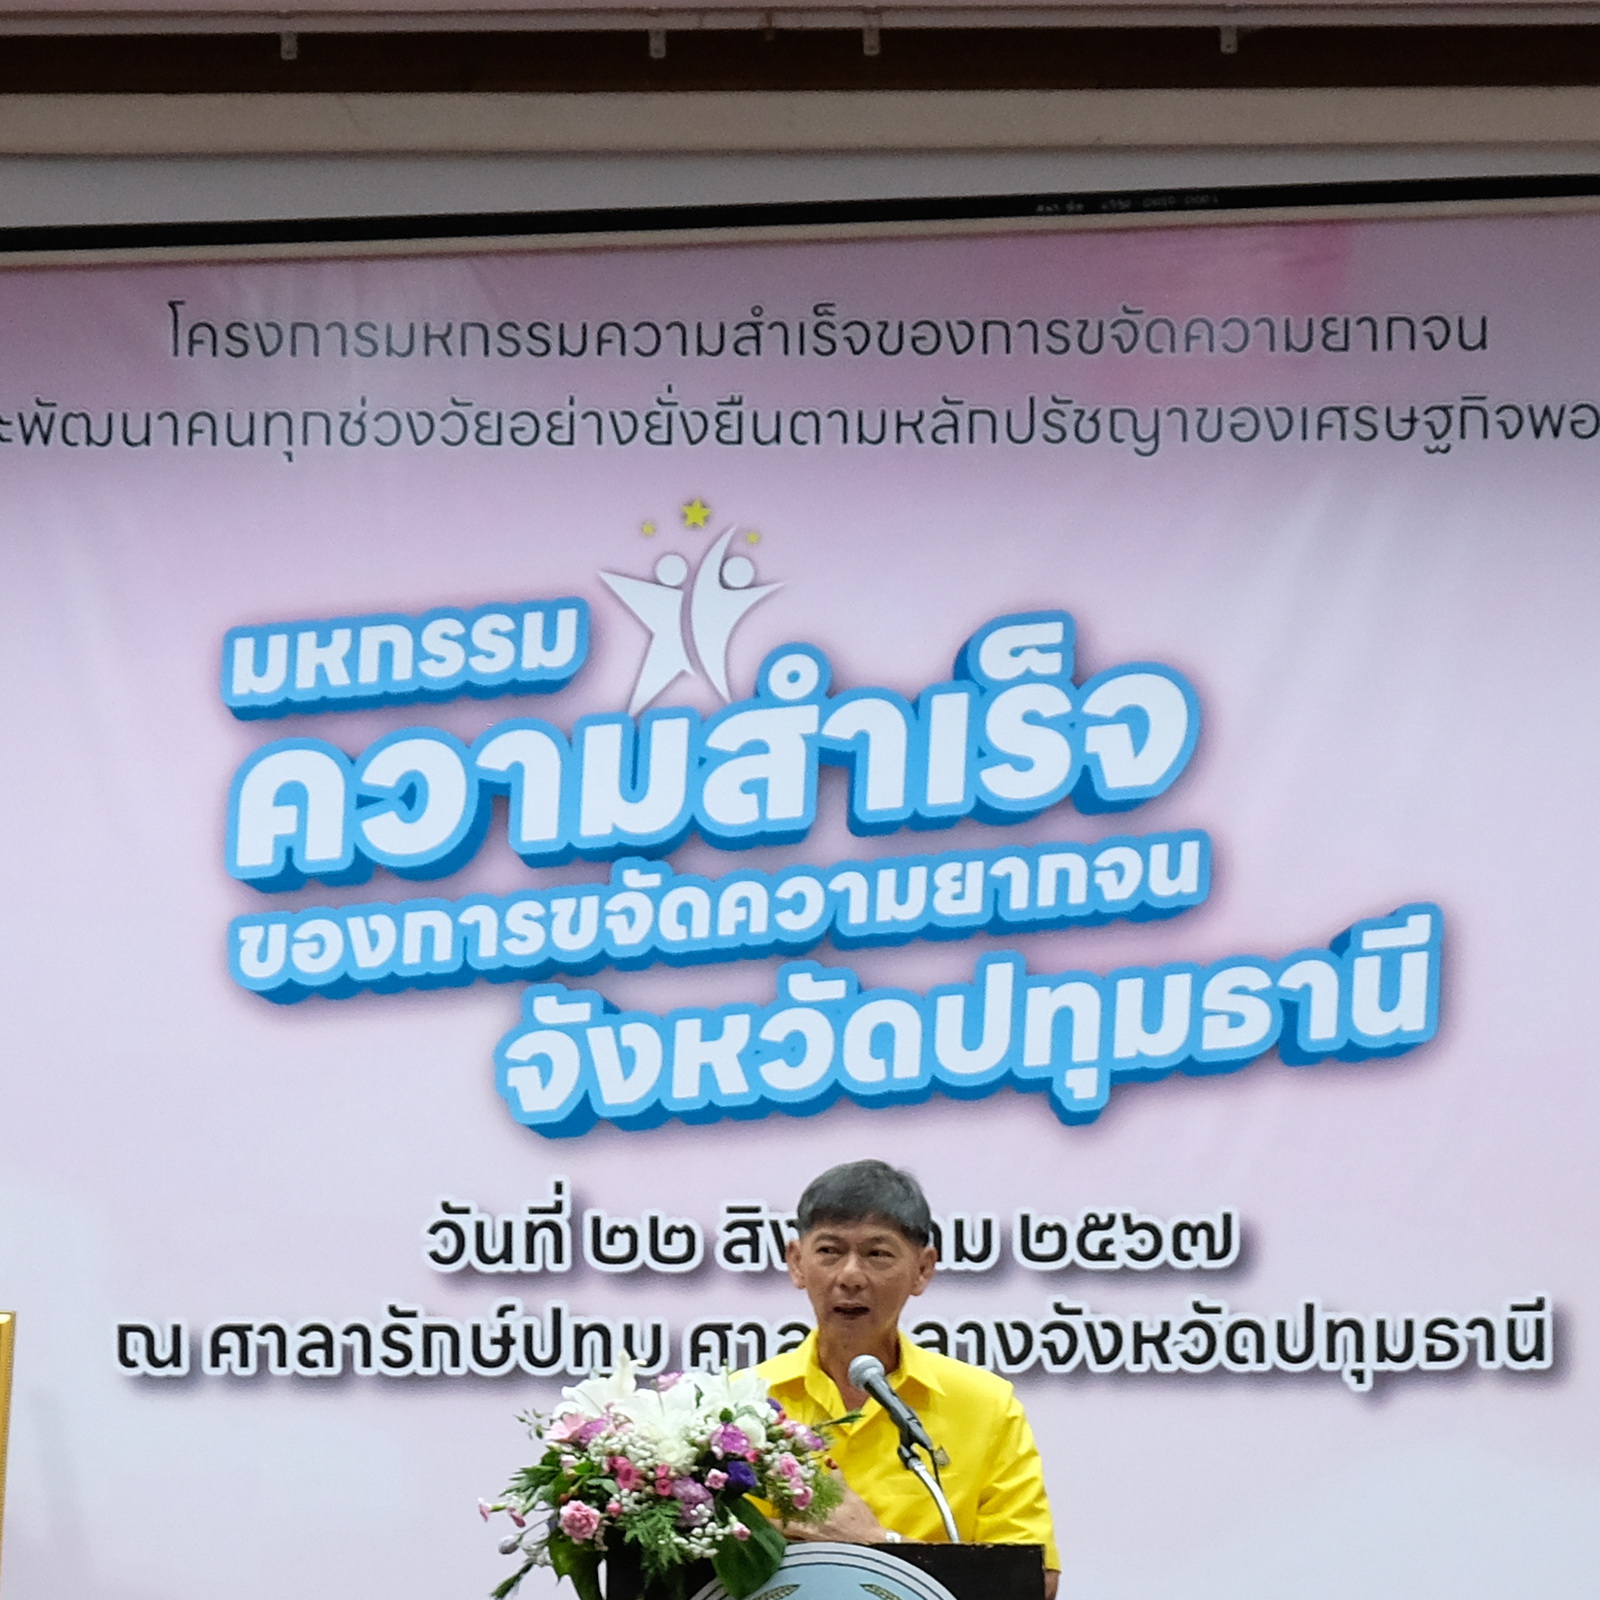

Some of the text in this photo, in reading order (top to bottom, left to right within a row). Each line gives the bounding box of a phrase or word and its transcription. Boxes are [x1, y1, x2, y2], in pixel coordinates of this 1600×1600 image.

[167, 300, 1488, 359] โครงการมหกรรมความสำเร็จของการขจัดความยากจน
[229, 607, 581, 698] มหกรรม
[234, 622, 1192, 868] ความสำเร็จ
[240, 840, 1201, 981] ของการขจัดความยากจน
[503, 913, 1432, 1116] จังหวัดปทุมธานี
[428, 1181, 1233, 1266] วันที่ ๒๒ สิงม ๒๕๖๗
[117, 1297, 1545, 1385] ณ ศาลารักษ์ปทม ศาลลางจังหวัดปทุมธานี
